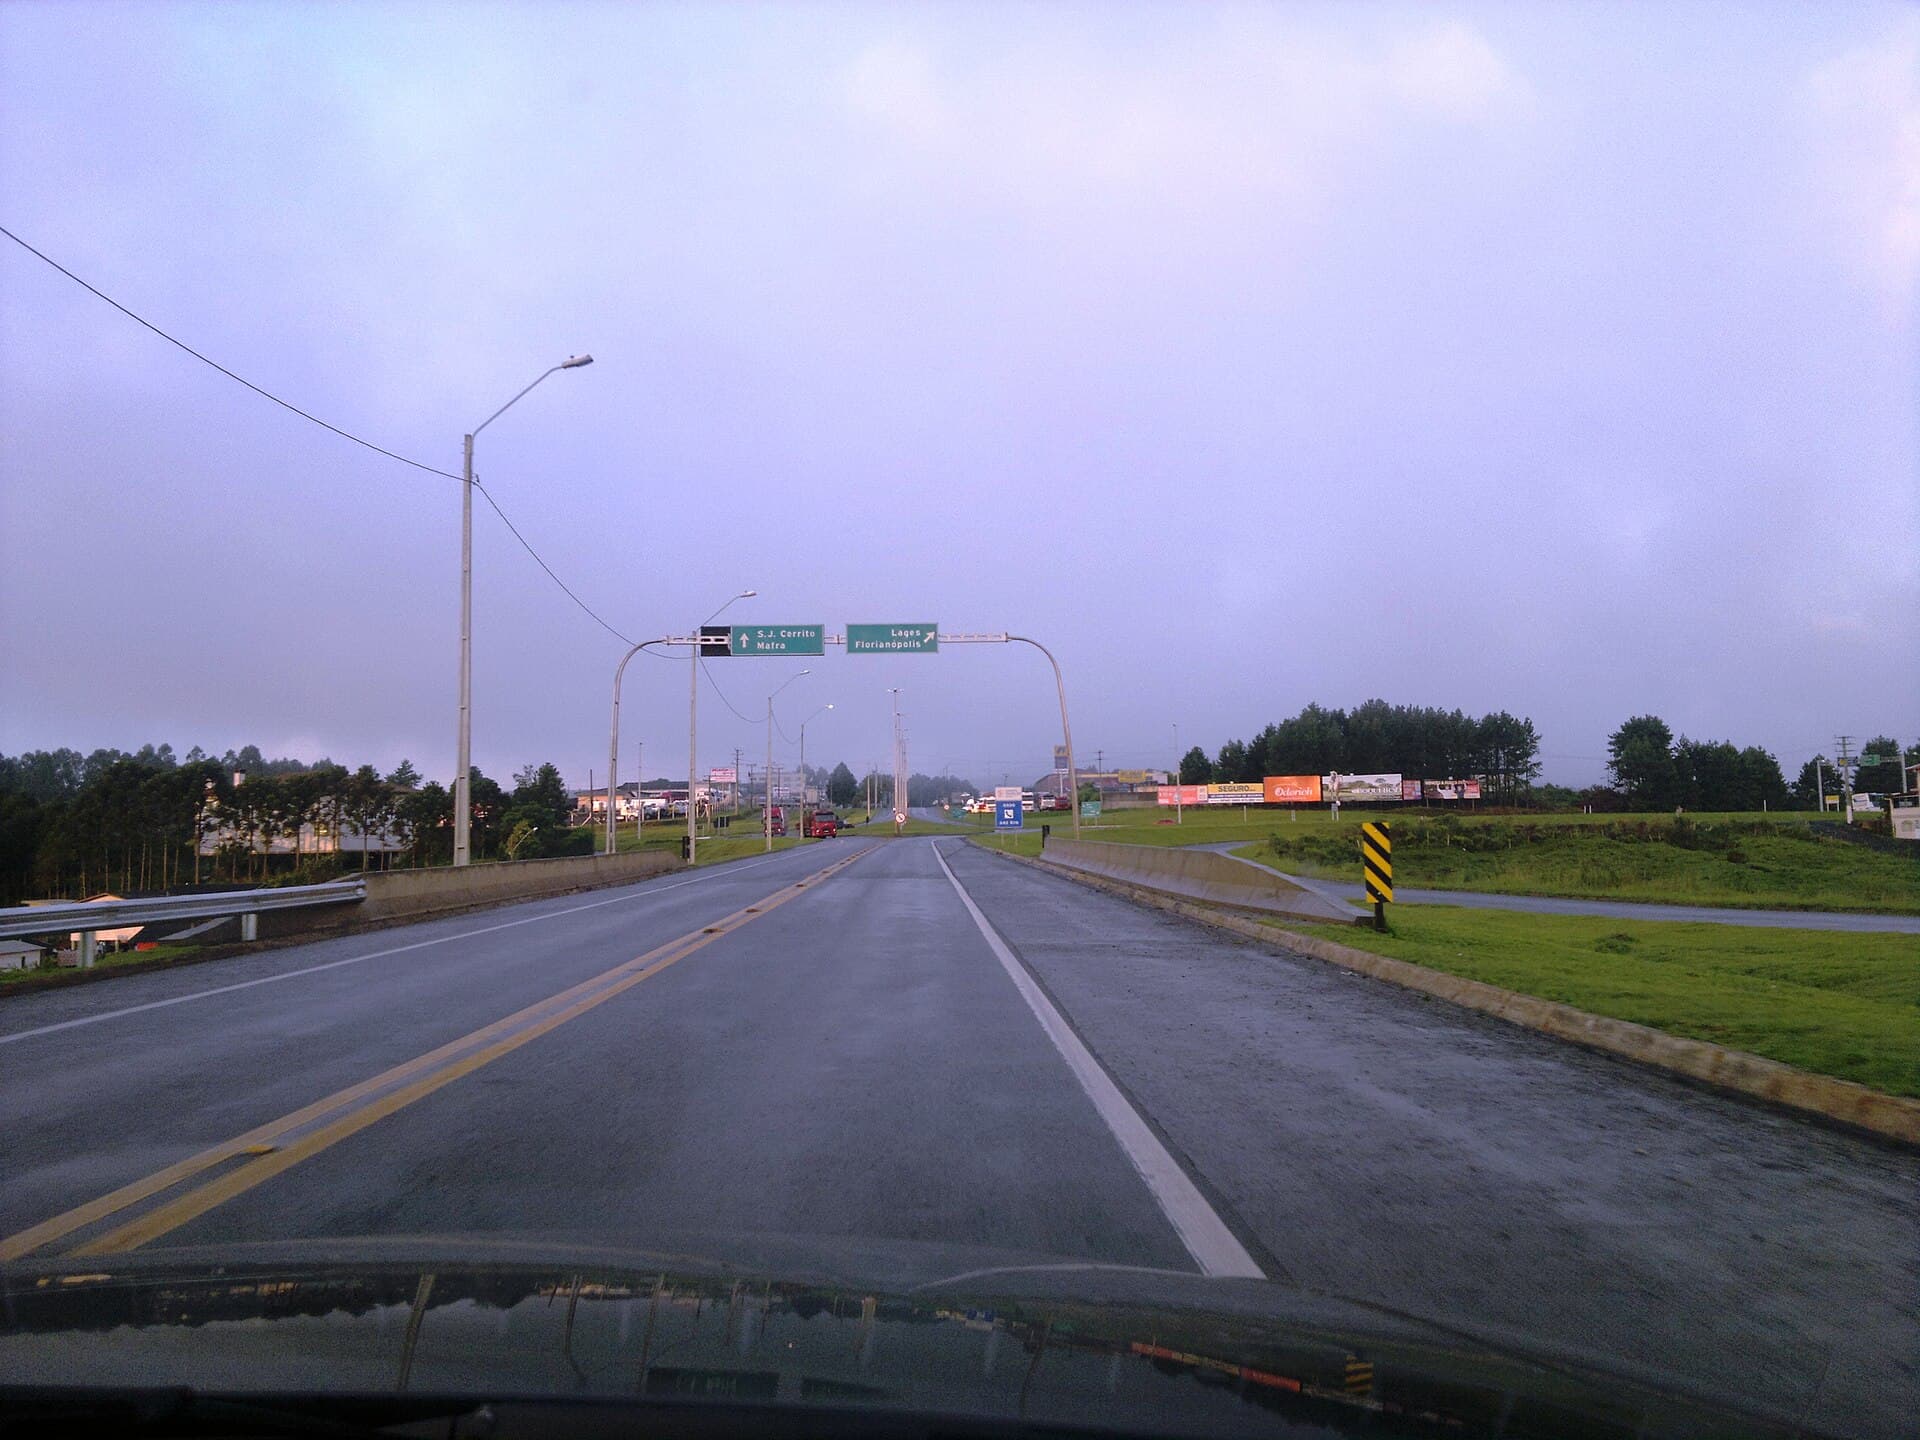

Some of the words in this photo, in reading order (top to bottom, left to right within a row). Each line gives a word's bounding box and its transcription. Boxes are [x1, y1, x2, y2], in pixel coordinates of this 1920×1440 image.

[757, 629, 776, 638] S.J.
[780, 629, 816, 638] Cerrito
[891, 629, 921, 638] Lages
[757, 641, 786, 649] Mafra
[855, 639, 921, 650] Florianópolis
